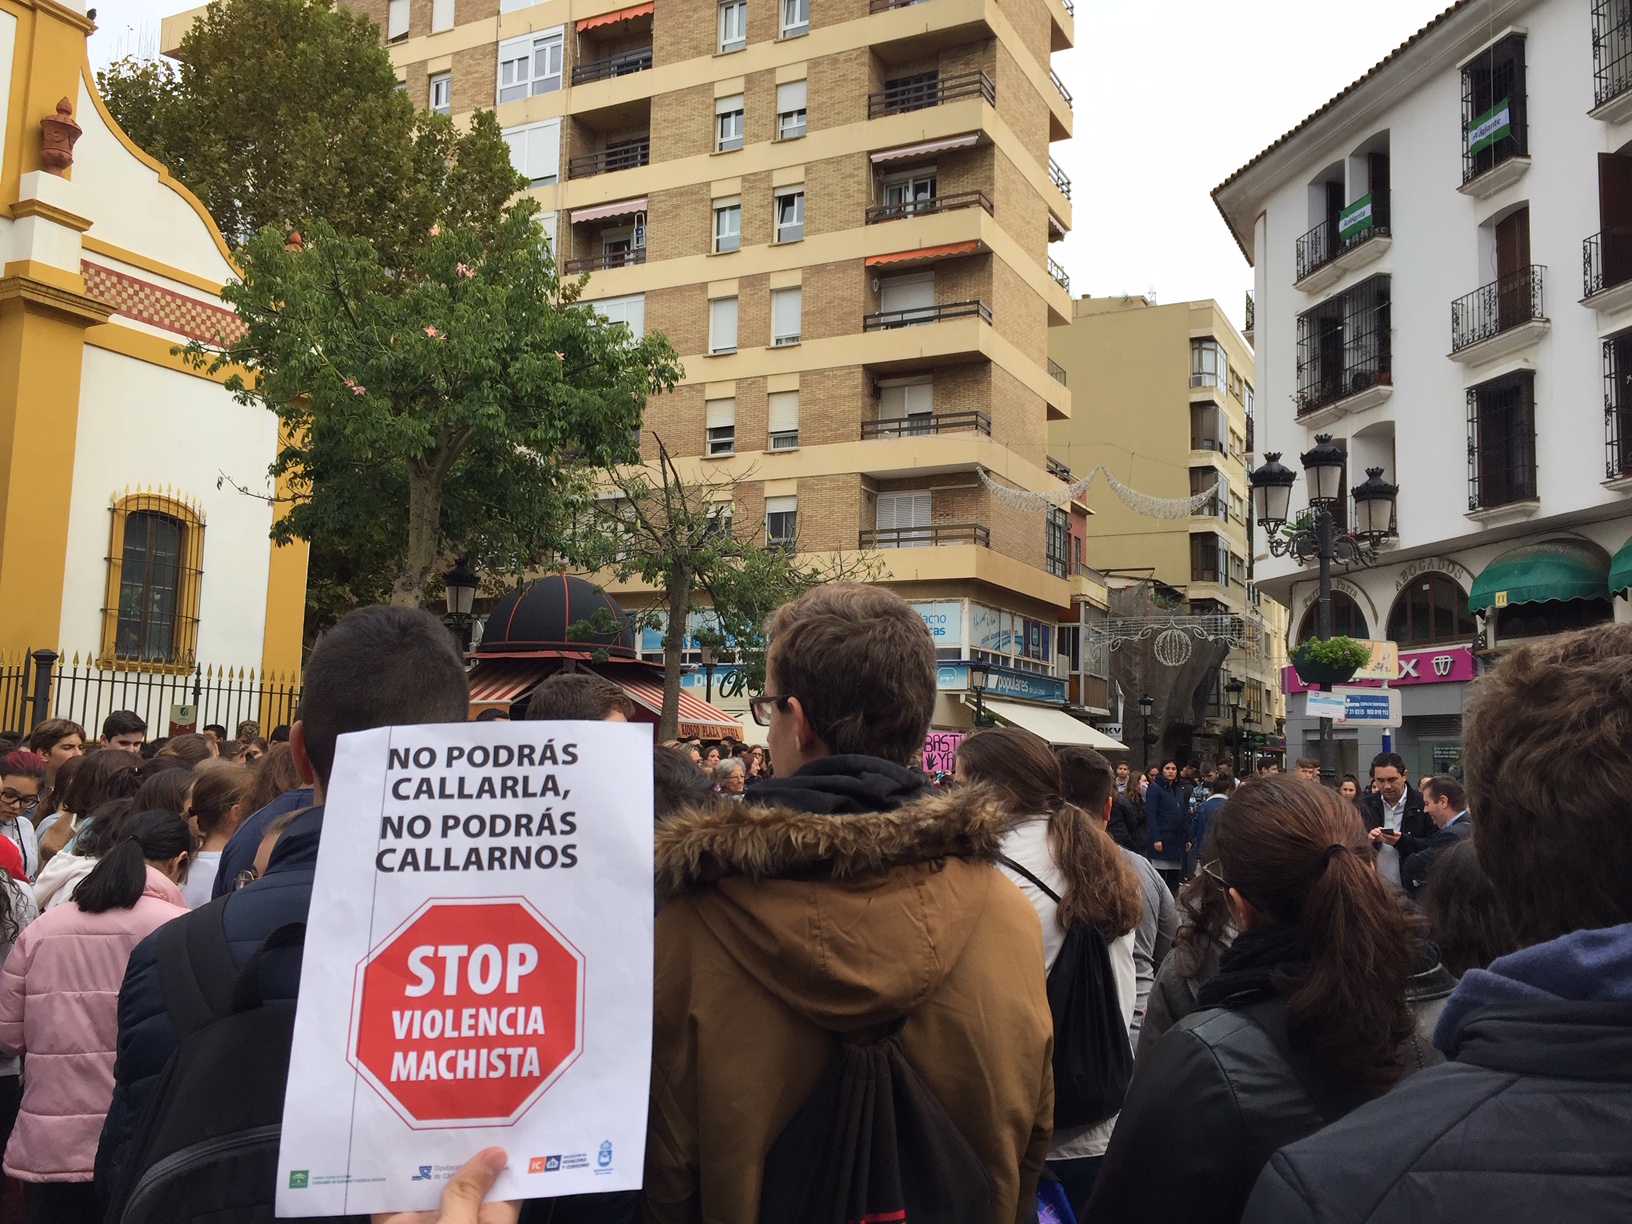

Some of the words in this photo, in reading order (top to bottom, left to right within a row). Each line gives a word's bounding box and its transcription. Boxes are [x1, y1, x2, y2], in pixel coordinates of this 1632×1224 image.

[1395, 556, 1464, 591] ABOGADOS
[1336, 579, 1358, 599] Parra
[998, 675, 1029, 693] populares
[681, 723, 700, 737] KIOSCO
[702, 725, 720, 738] PLAZA
[387, 746, 437, 770] NO
[446, 738, 579, 768] PODRÁS
[938, 751, 954, 770] YA
[391, 774, 571, 801] CALLARLA,
[380, 814, 432, 840] NO
[441, 807, 577, 838] PODRÁS
[375, 844, 579, 873] CALLARNOS
[404, 942, 539, 998] STOP
[391, 1006, 545, 1040] VIOLENCIA
[390, 1046, 541, 1082] MACHISTA
[531, 1161, 542, 1170] IC
